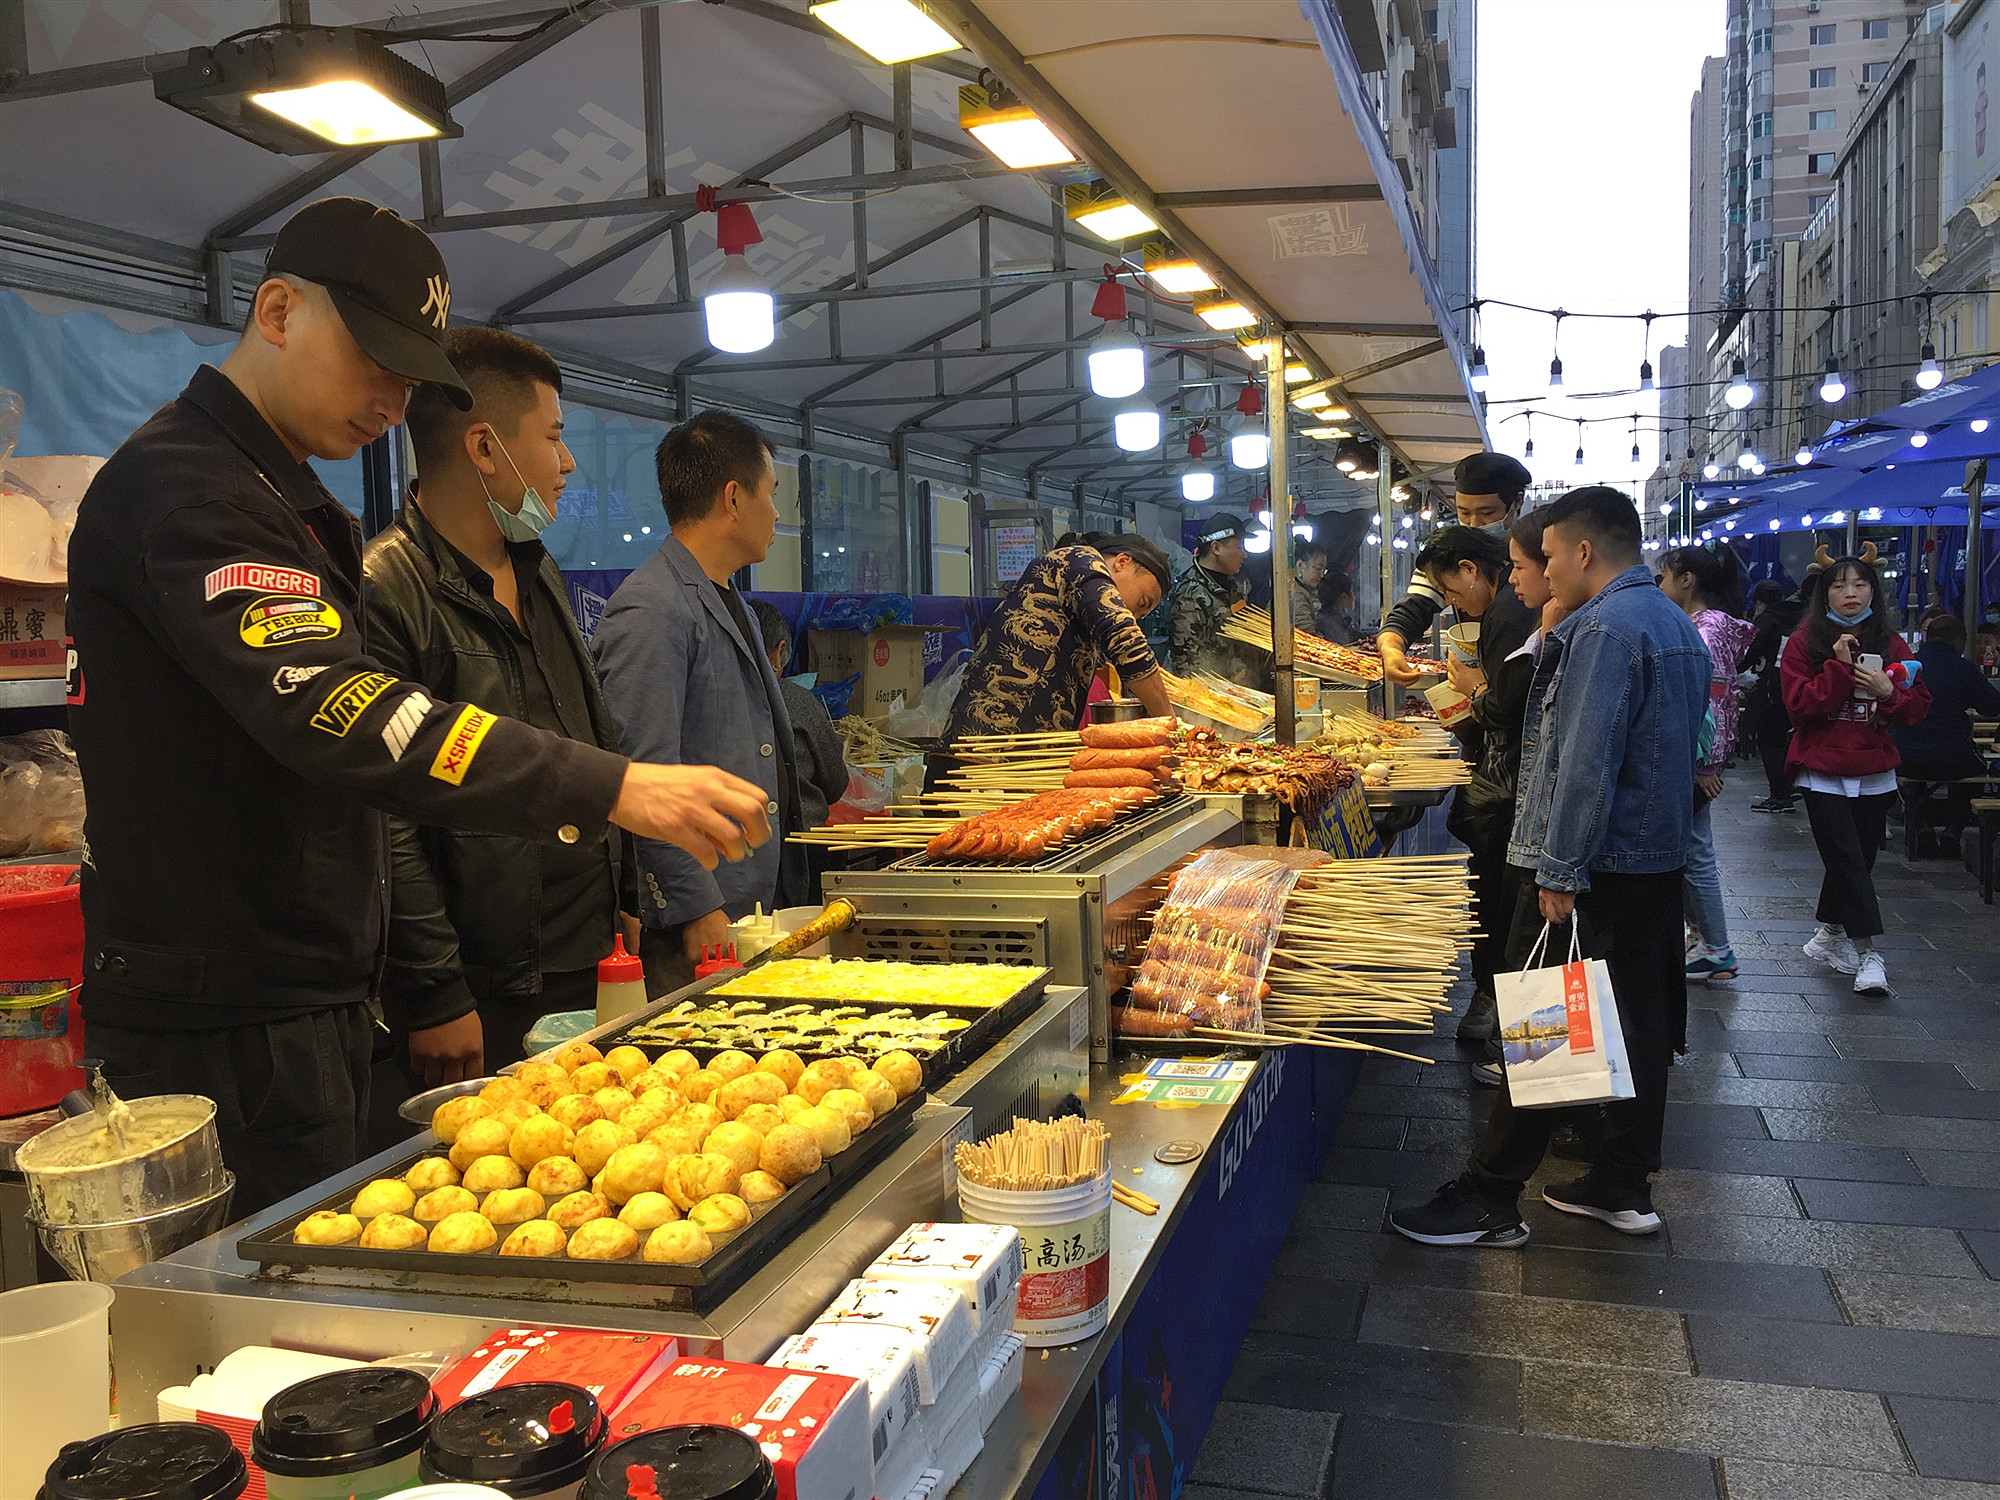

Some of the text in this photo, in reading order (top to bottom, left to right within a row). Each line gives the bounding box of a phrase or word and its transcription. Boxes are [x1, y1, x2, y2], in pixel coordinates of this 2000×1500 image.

[247, 568, 315, 595] ORGRS
[268, 601, 318, 615] ORIGINAL
[259, 613, 325, 632] TEEBOX
[272, 629, 294, 640] CUP
[311, 672, 397, 737] VIRTUAL
[672, 1363, 729, 1379] 静竹
